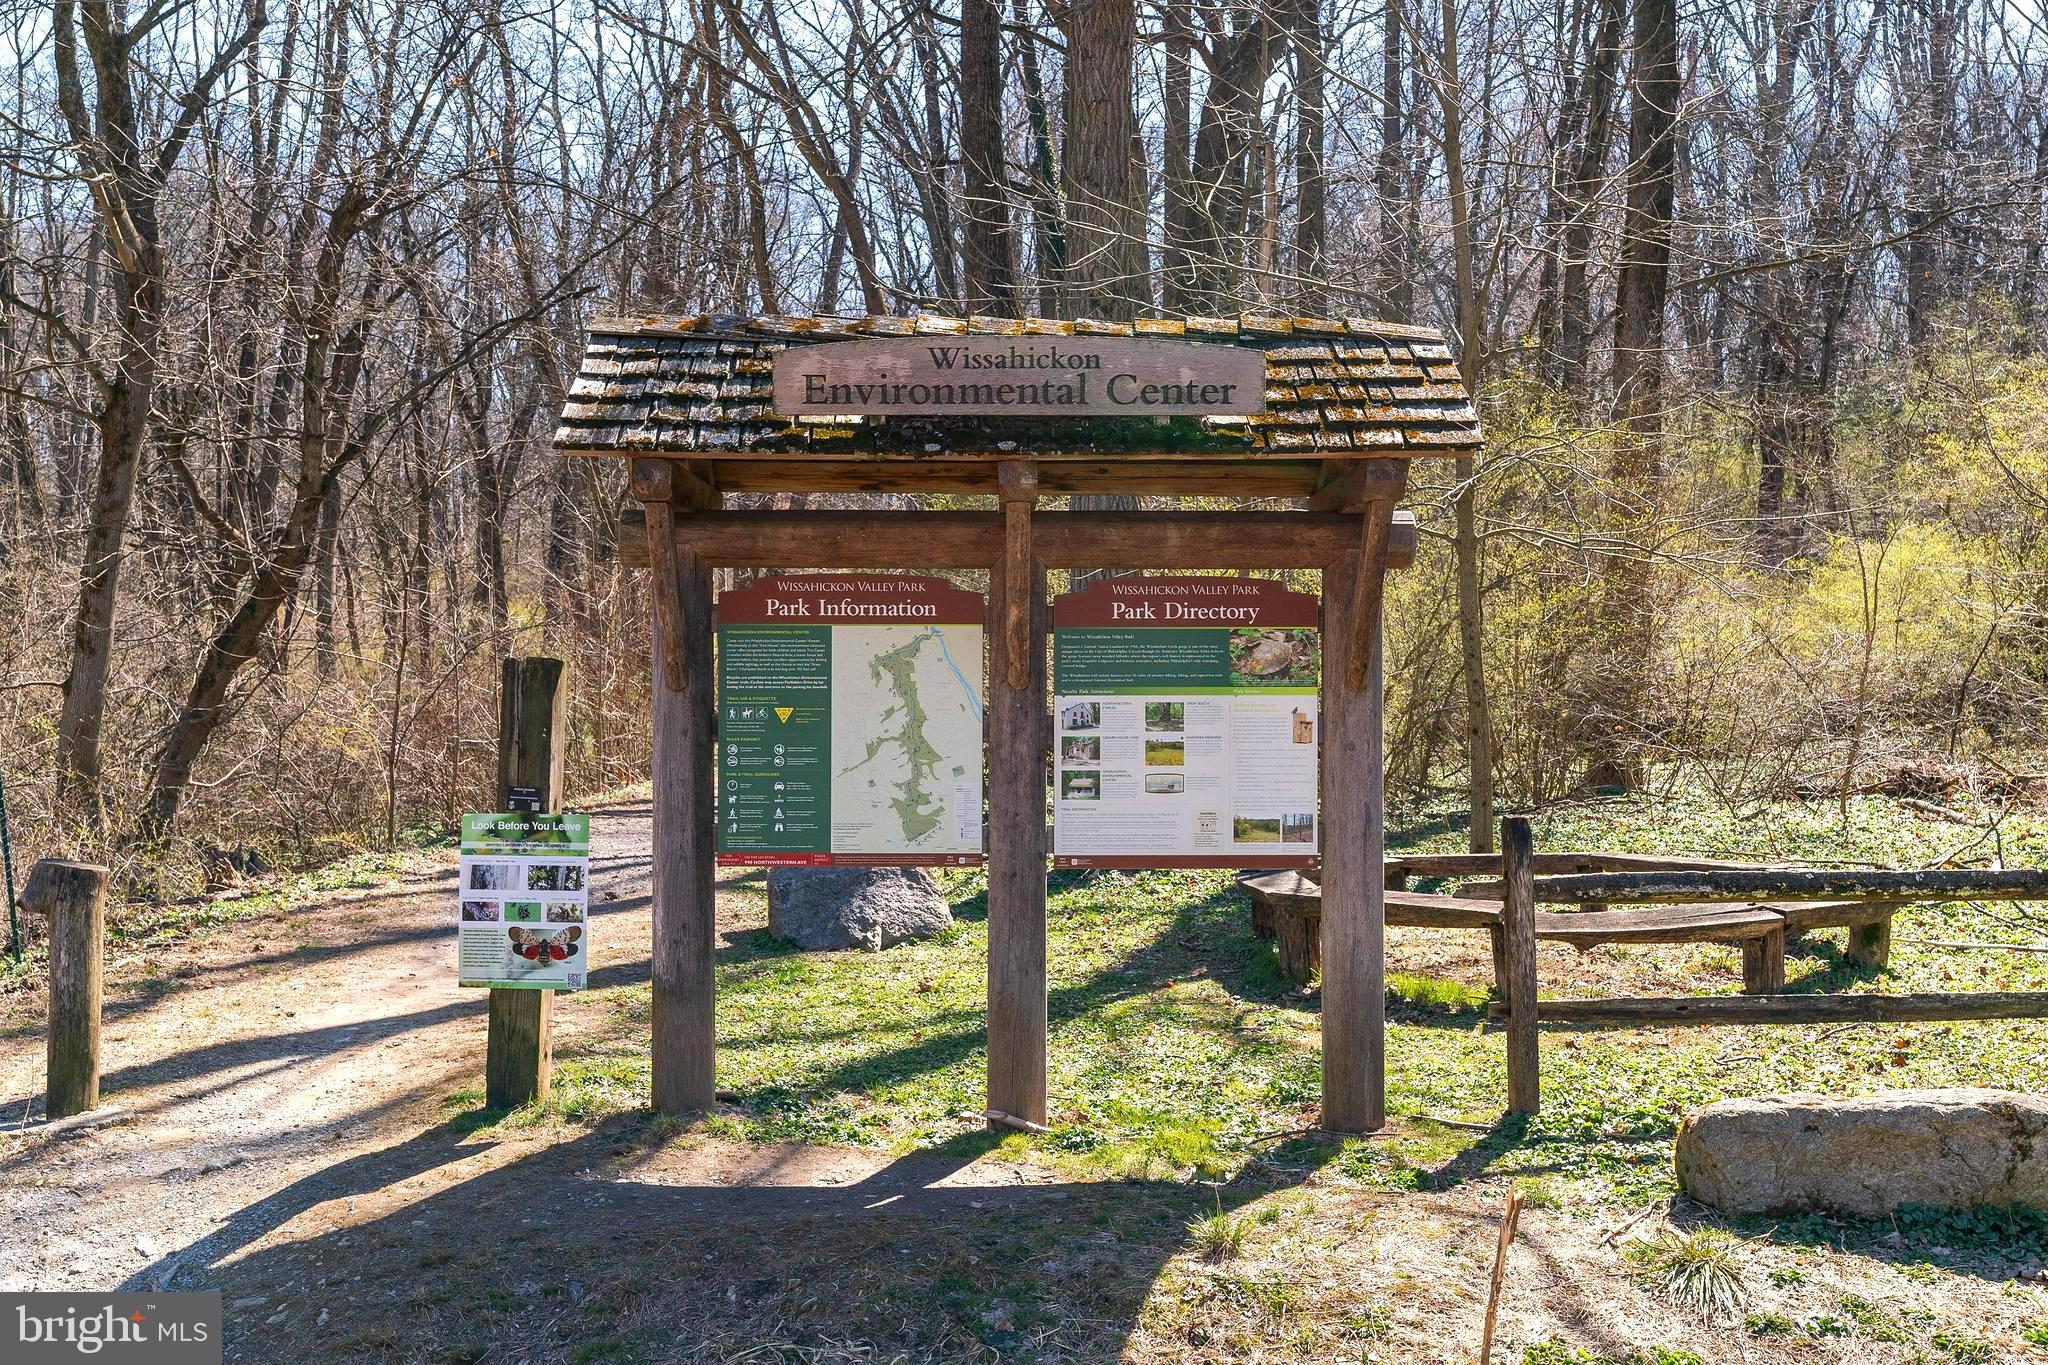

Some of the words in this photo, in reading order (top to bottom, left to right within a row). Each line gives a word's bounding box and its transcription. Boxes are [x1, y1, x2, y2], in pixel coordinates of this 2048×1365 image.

[927, 346, 1100, 370] Wissahickon
[802, 374, 1088, 406] Environmental
[1107, 374, 1236, 406] Center
[777, 582, 854, 592] WISSAHICKON
[857, 582, 895, 592] VALLEY
[898, 582, 926, 592] PARK
[1112, 584, 1188, 595] WISSAHICKON
[1191, 584, 1230, 595] VALLEY
[1232, 584, 1260, 595] PARK
[766, 599, 810, 616] Park
[819, 599, 936, 616] Information
[1112, 602, 1156, 619] Park
[1164, 602, 1260, 624] Directory
[471, 821, 495, 830] Look
[498, 821, 530, 830] Before
[531, 822, 550, 830] You
[552, 822, 581, 831] Leave
